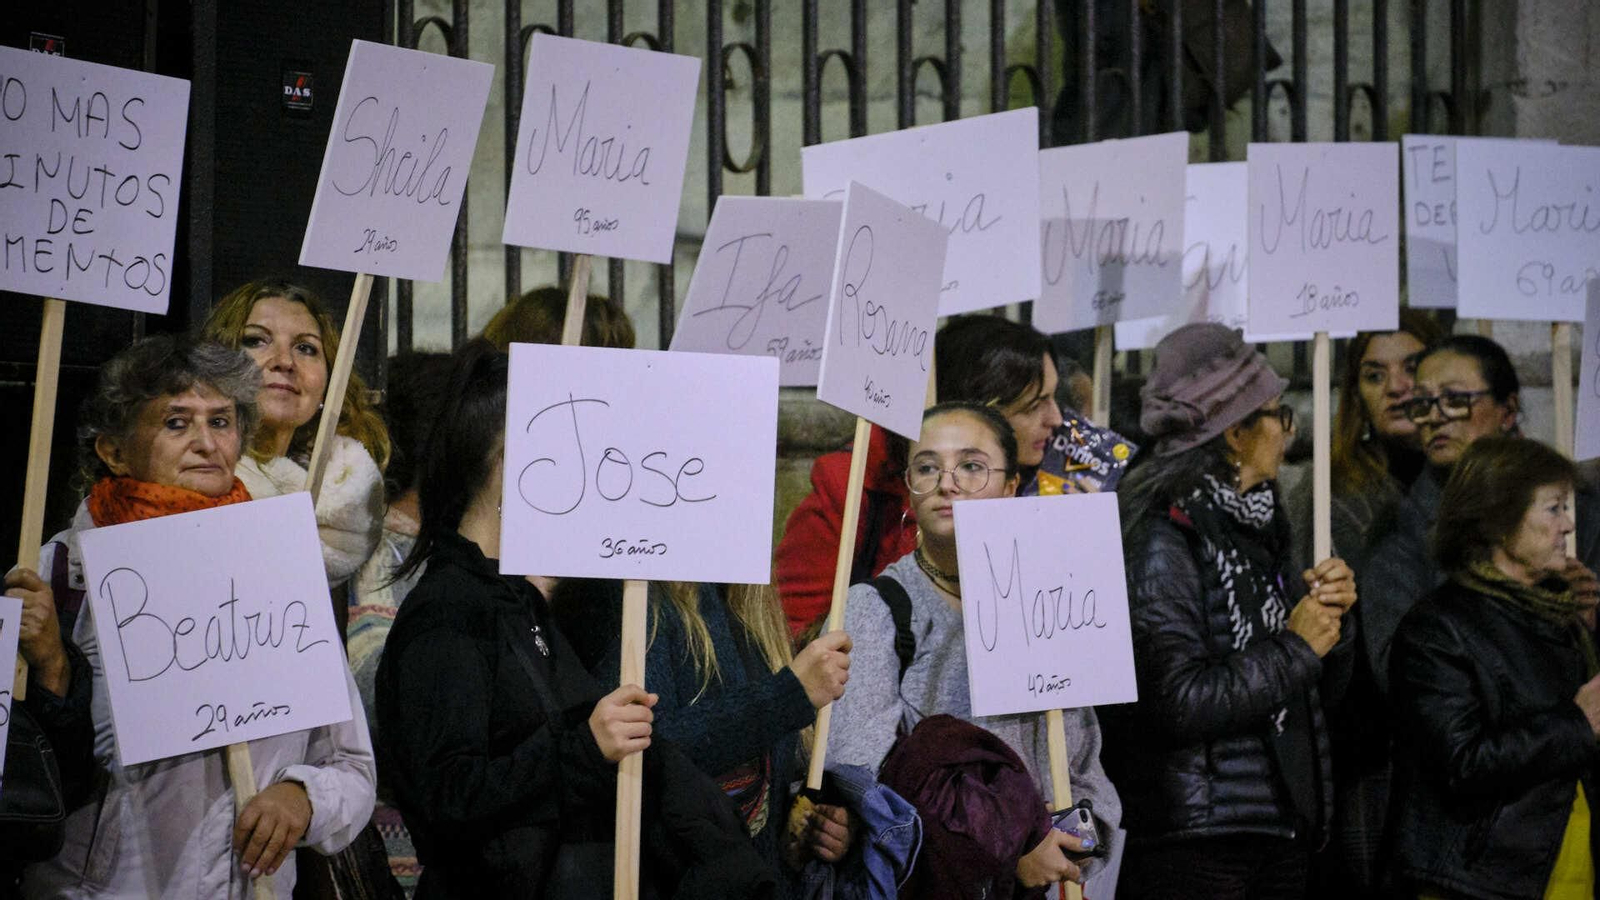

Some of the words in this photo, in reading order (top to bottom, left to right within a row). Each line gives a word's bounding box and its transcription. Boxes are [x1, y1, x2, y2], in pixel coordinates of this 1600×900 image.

[52, 87, 145, 150] MAS
[284, 85, 311, 98] DAS
[332, 96, 452, 206] Sheila
[527, 80, 650, 186] Maria
[1407, 144, 1451, 190] TE
[47, 198, 94, 235] DE
[573, 208, 591, 234] 95
[1042, 180, 1168, 287] Maria
[1260, 163, 1389, 255] Maria
[517, 392, 717, 516] Jose
[1053, 434, 1110, 476] Doritos
[599, 537, 627, 559] 36
[627, 539, 668, 556] años
[99, 567, 330, 683] Beatriz
[977, 537, 1107, 652] Maria
[191, 703, 230, 742] 29
[233, 702, 290, 728] años
